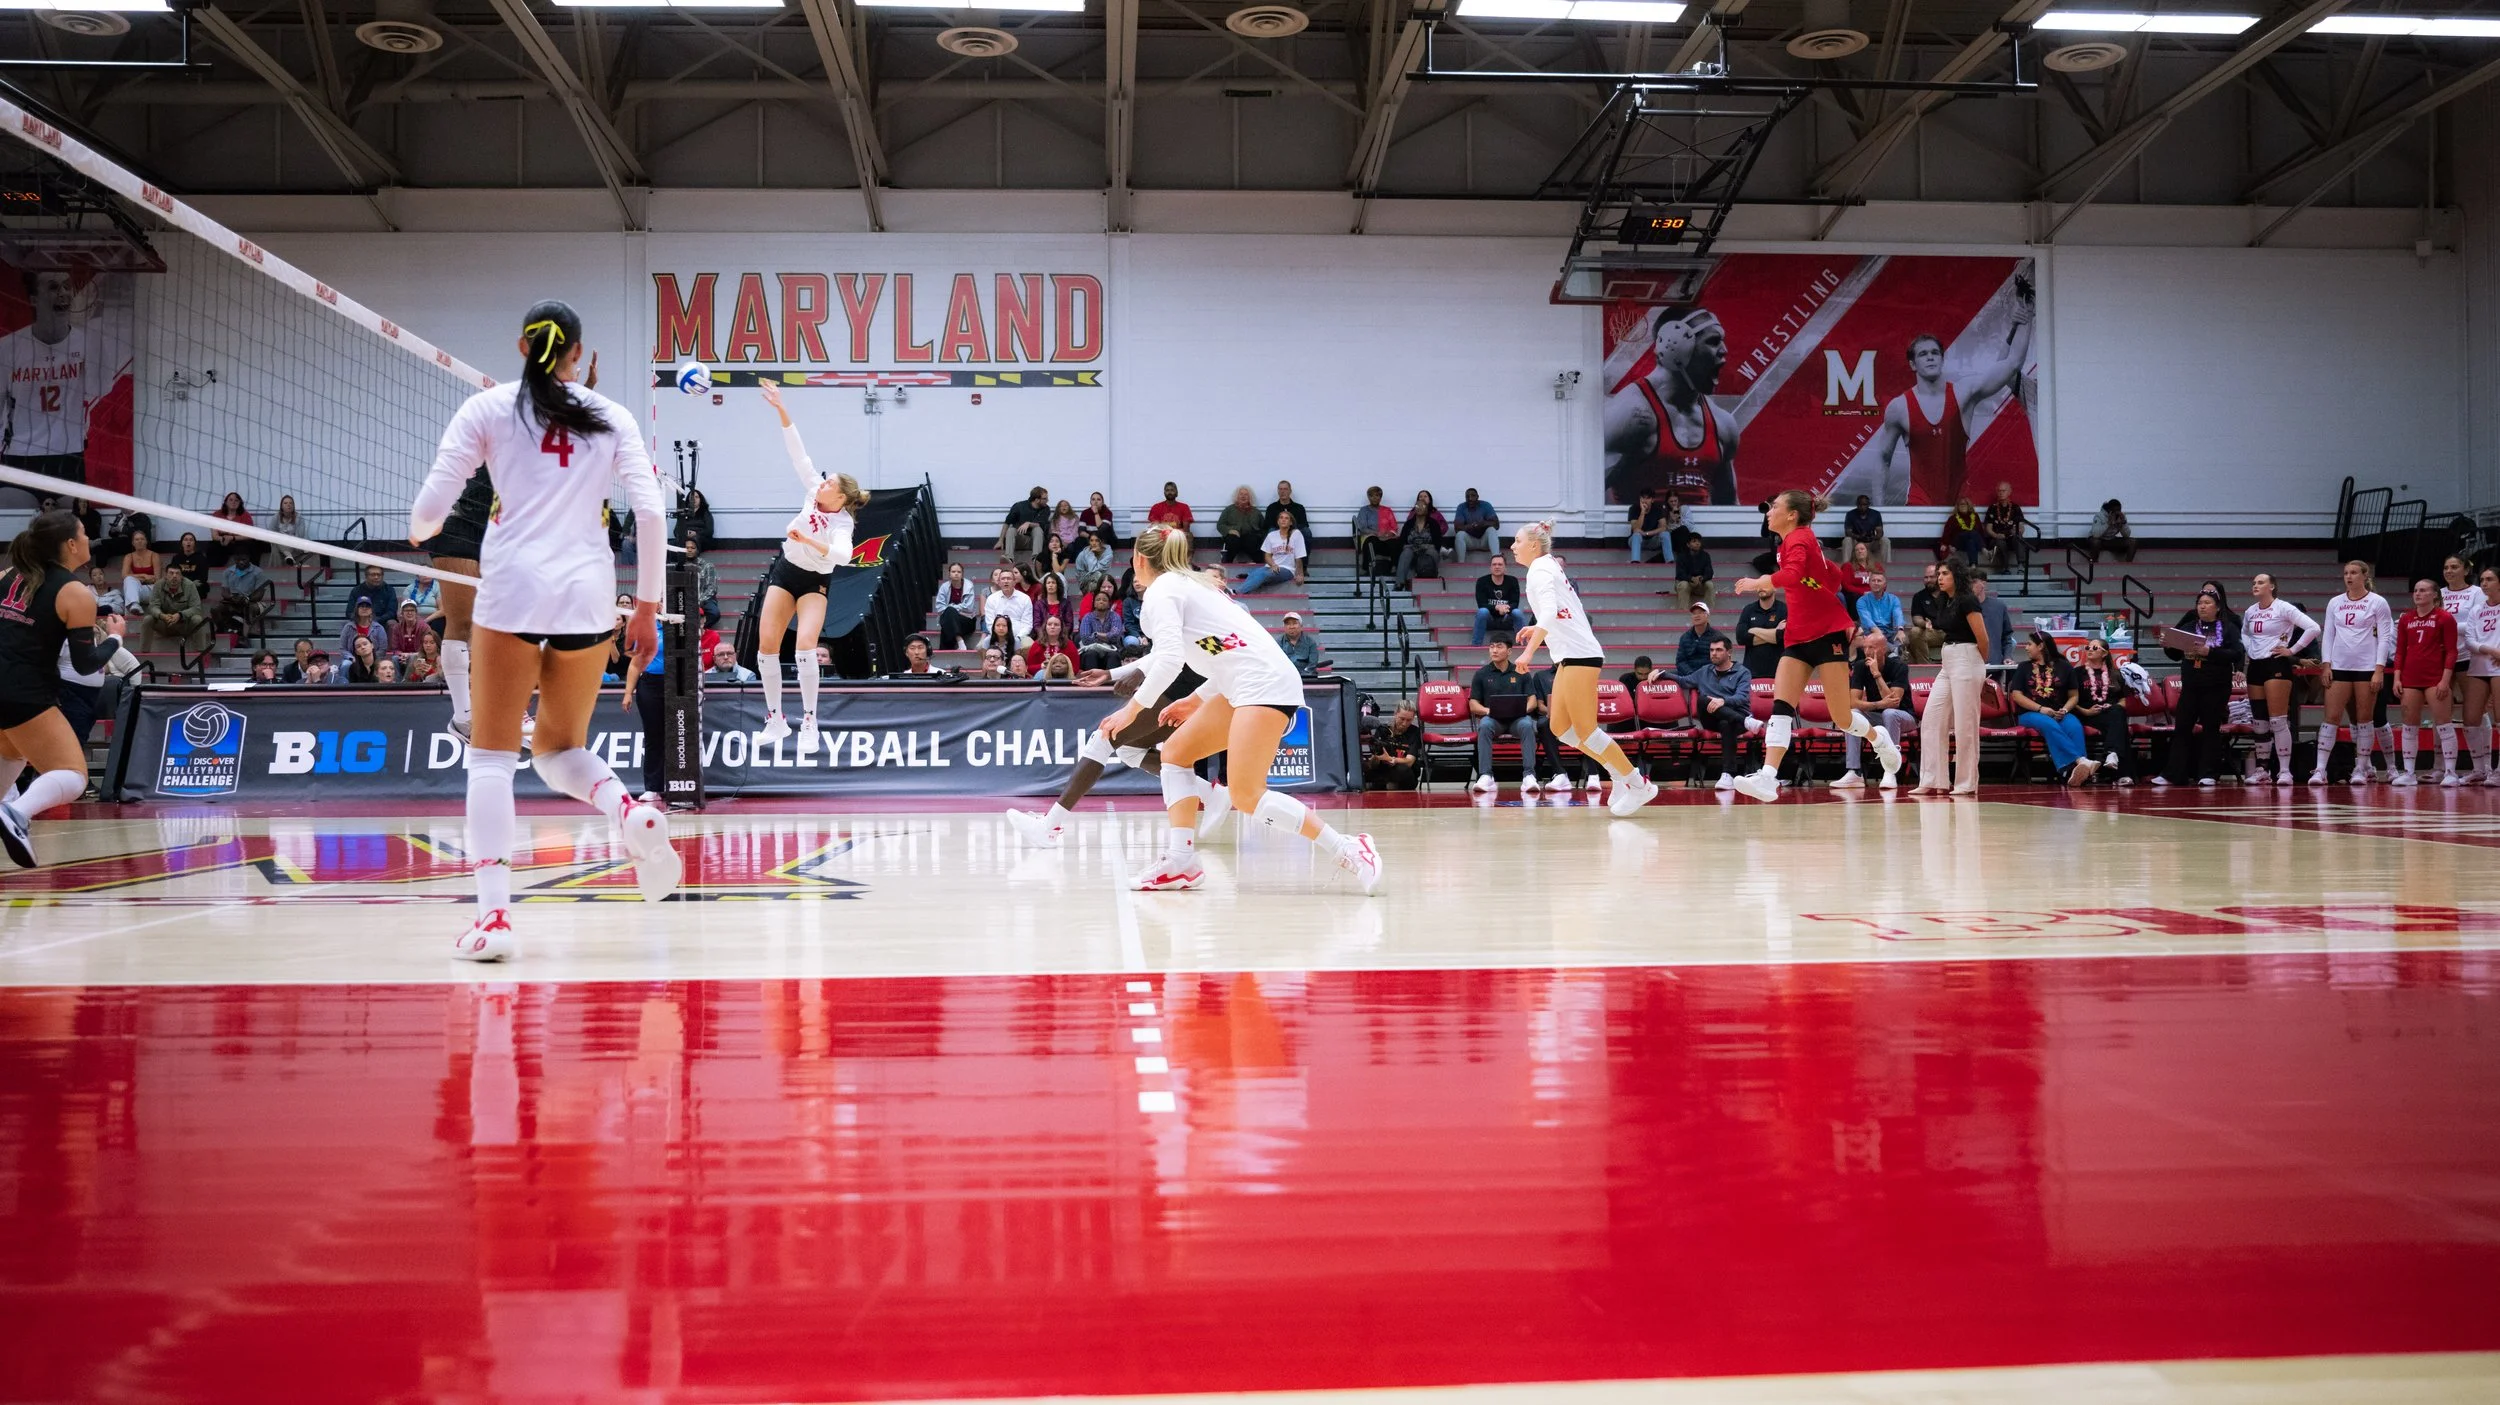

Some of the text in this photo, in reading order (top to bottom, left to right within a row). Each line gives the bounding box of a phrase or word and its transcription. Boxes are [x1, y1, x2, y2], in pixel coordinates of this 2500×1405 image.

[23, 112, 62, 150] MARYLAND
[142, 182, 174, 214] MARYLAND
[1651, 218, 1685, 229] 1:30
[652, 272, 1104, 363] MARYLAND
[1738, 268, 1840, 381] WRESTLING
[1823, 350, 1879, 407] M
[40, 385, 60, 413] 12
[541, 418, 574, 468] 4
[1810, 424, 1873, 496] MARYLAND
[2445, 603, 2460, 615] 23
[2345, 613, 2355, 625] 12
[2407, 620, 2436, 629] MARYLAND
[2483, 618, 2496, 632] 22
[2253, 620, 2263, 633] 10
[2416, 630, 2424, 643] 7
[2066, 647, 2080, 663] G
[1425, 685, 1461, 694] MARYLAND
[1596, 684, 1625, 693] ARYLAND
[1642, 684, 1677, 693] MARYLAND
[1750, 683, 1775, 691] MARYLA
[1804, 684, 1824, 693] MARYL
[1911, 682, 1932, 690] MARYL
[677, 709, 686, 769] sports imports
[702, 730, 950, 767] VOLLEYBALL
[1277, 748, 1308, 756] SCOVER
[194, 757, 234, 765] DISCOVER
[1275, 757, 1309, 765] YBALL
[166, 766, 234, 774] VOLLEYBALL
[1268, 766, 1310, 776] LLENGE
[163, 775, 233, 786] CHALLENGE
